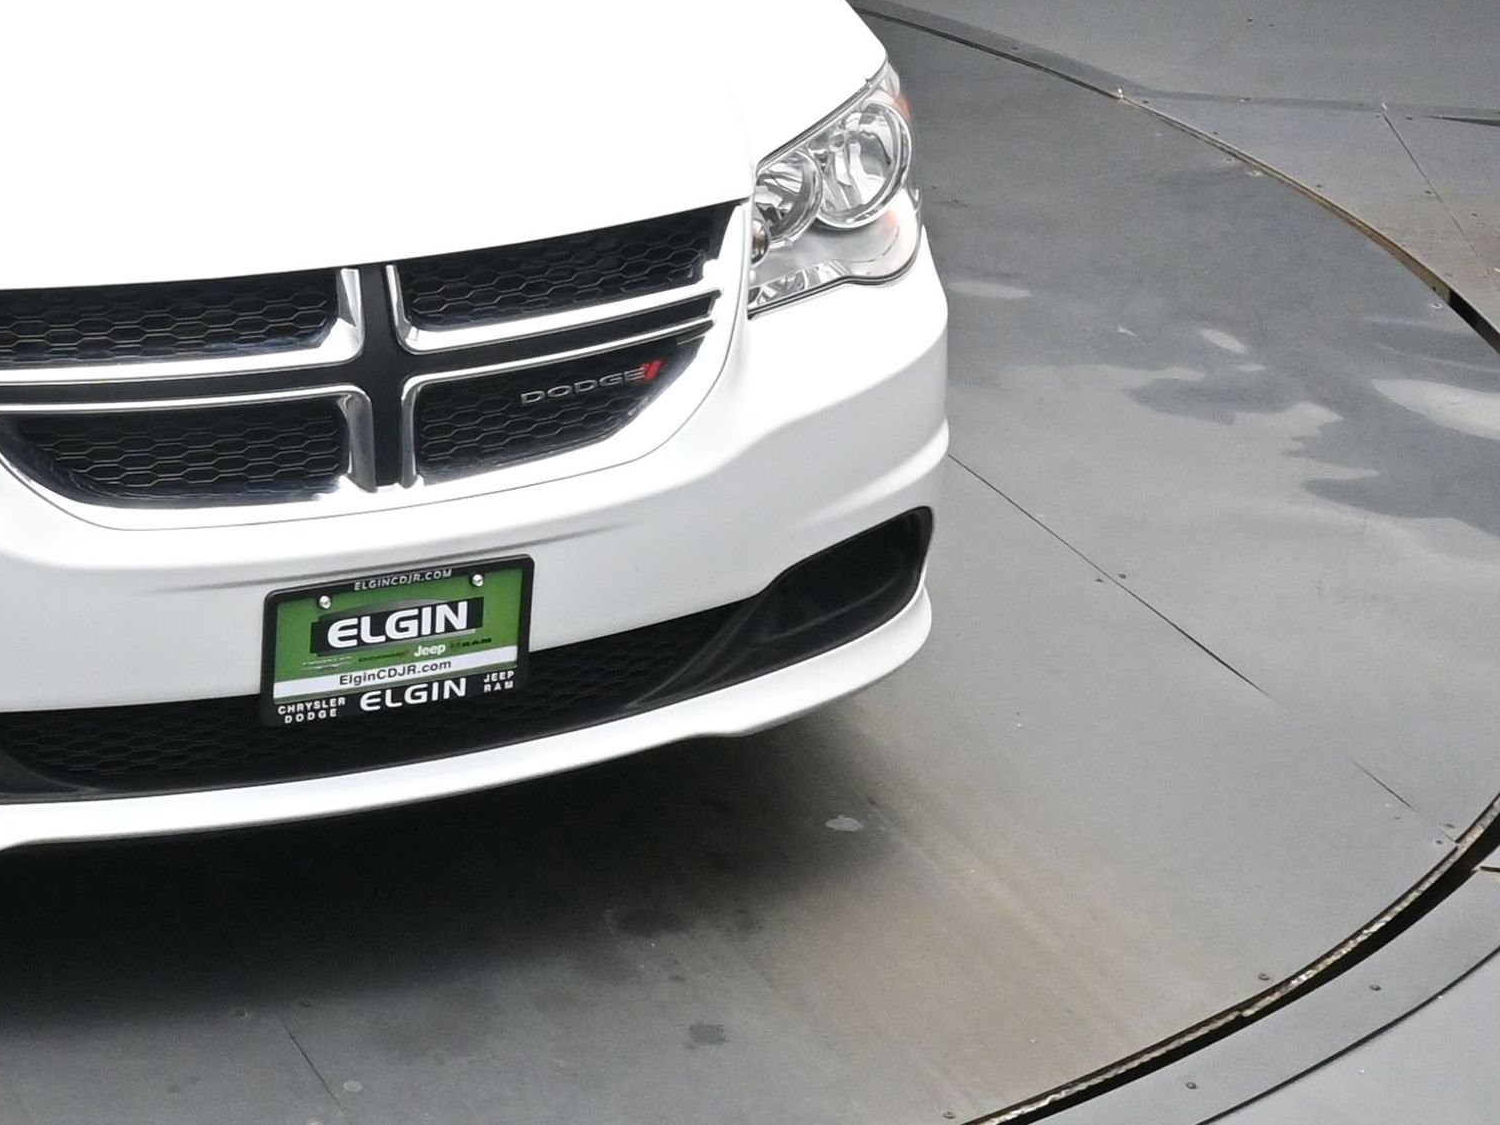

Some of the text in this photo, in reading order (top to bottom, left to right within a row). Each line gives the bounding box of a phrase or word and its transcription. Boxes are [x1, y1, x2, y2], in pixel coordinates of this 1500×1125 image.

[520, 367, 645, 404] DODGE
[354, 569, 453, 591] ELGINCDJR.COM
[327, 600, 468, 649] ELGIN
[413, 642, 447, 658] Jeep
[339, 659, 452, 687] ElginCDJR.com
[483, 670, 515, 683] JEEP
[359, 677, 467, 712] ELGIN
[483, 680, 514, 693] RAM
[278, 696, 346, 716] CHRYSLER
[284, 708, 338, 724] DODGE
